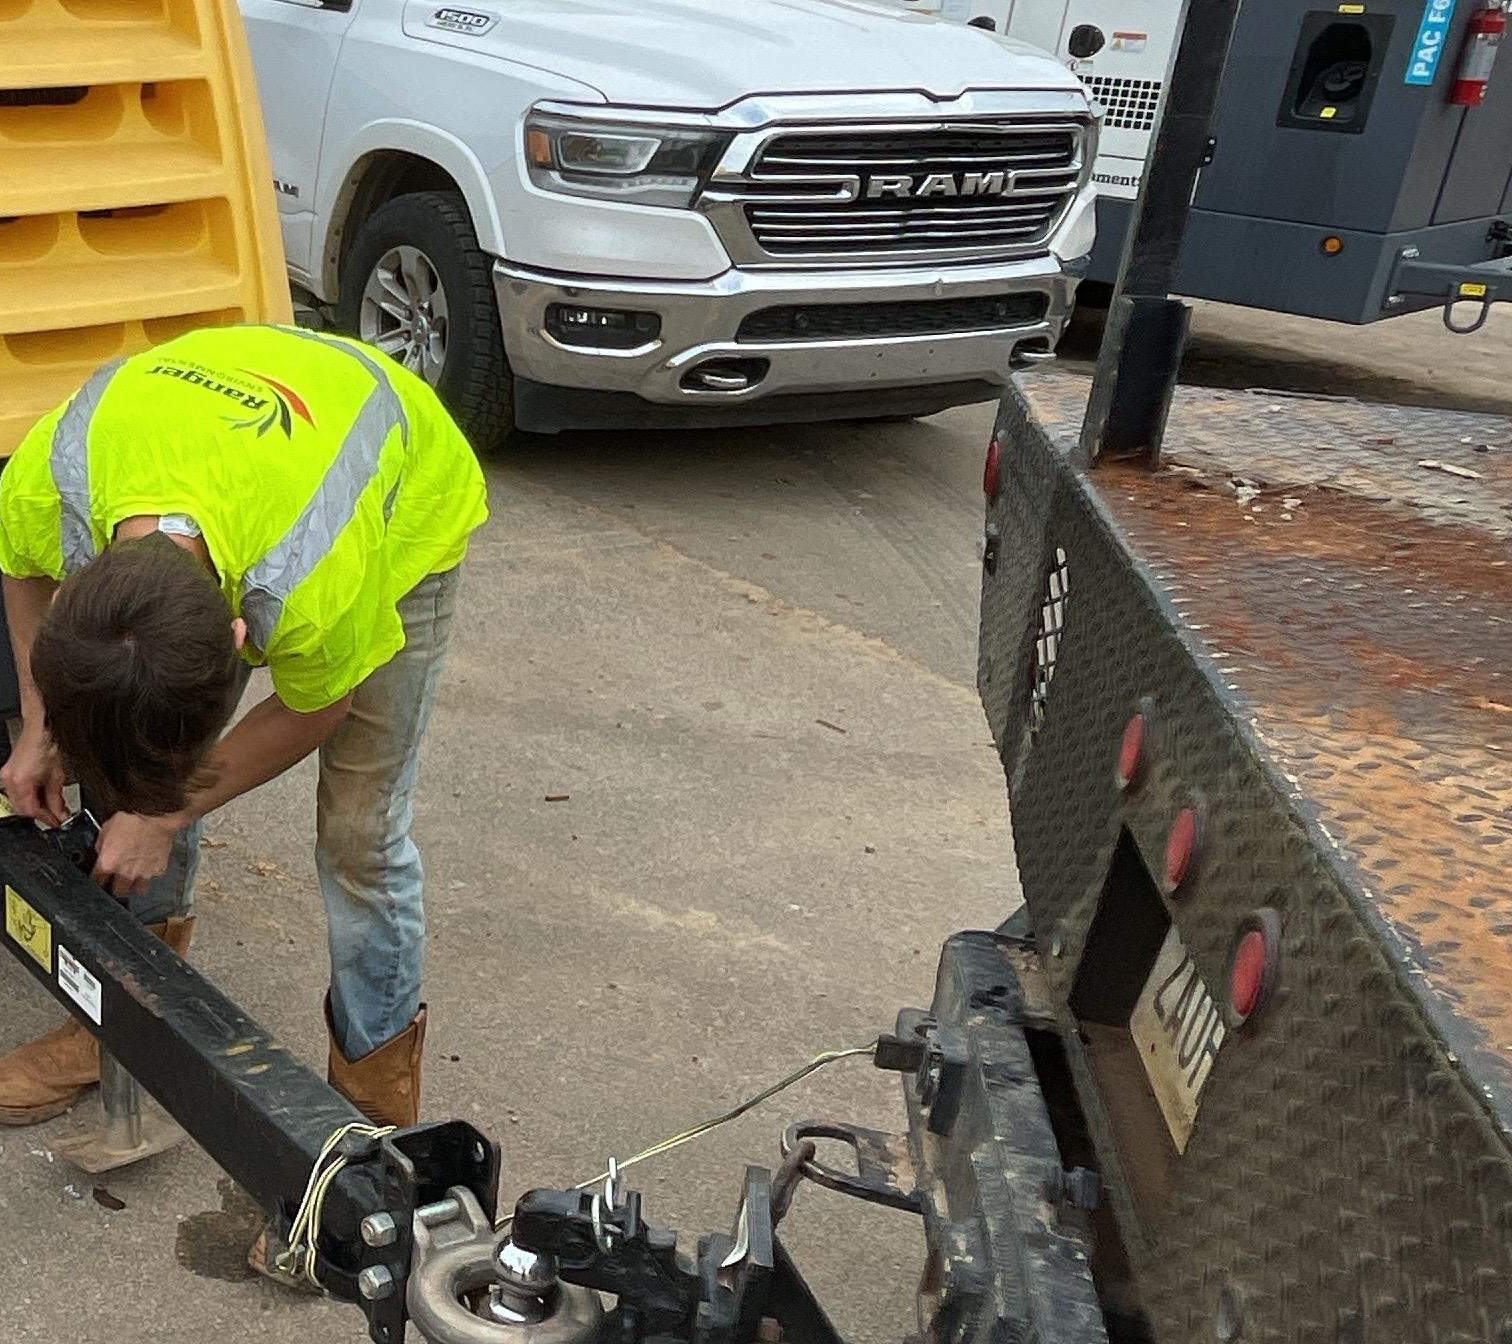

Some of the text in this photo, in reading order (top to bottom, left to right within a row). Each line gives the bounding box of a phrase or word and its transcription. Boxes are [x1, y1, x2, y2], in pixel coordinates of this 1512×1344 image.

[1411, 30, 1442, 77] PAC
[866, 171, 1006, 199] RAM
[144, 365, 270, 411] Ranger
[157, 357, 264, 394] ENVIRONMENTAL
